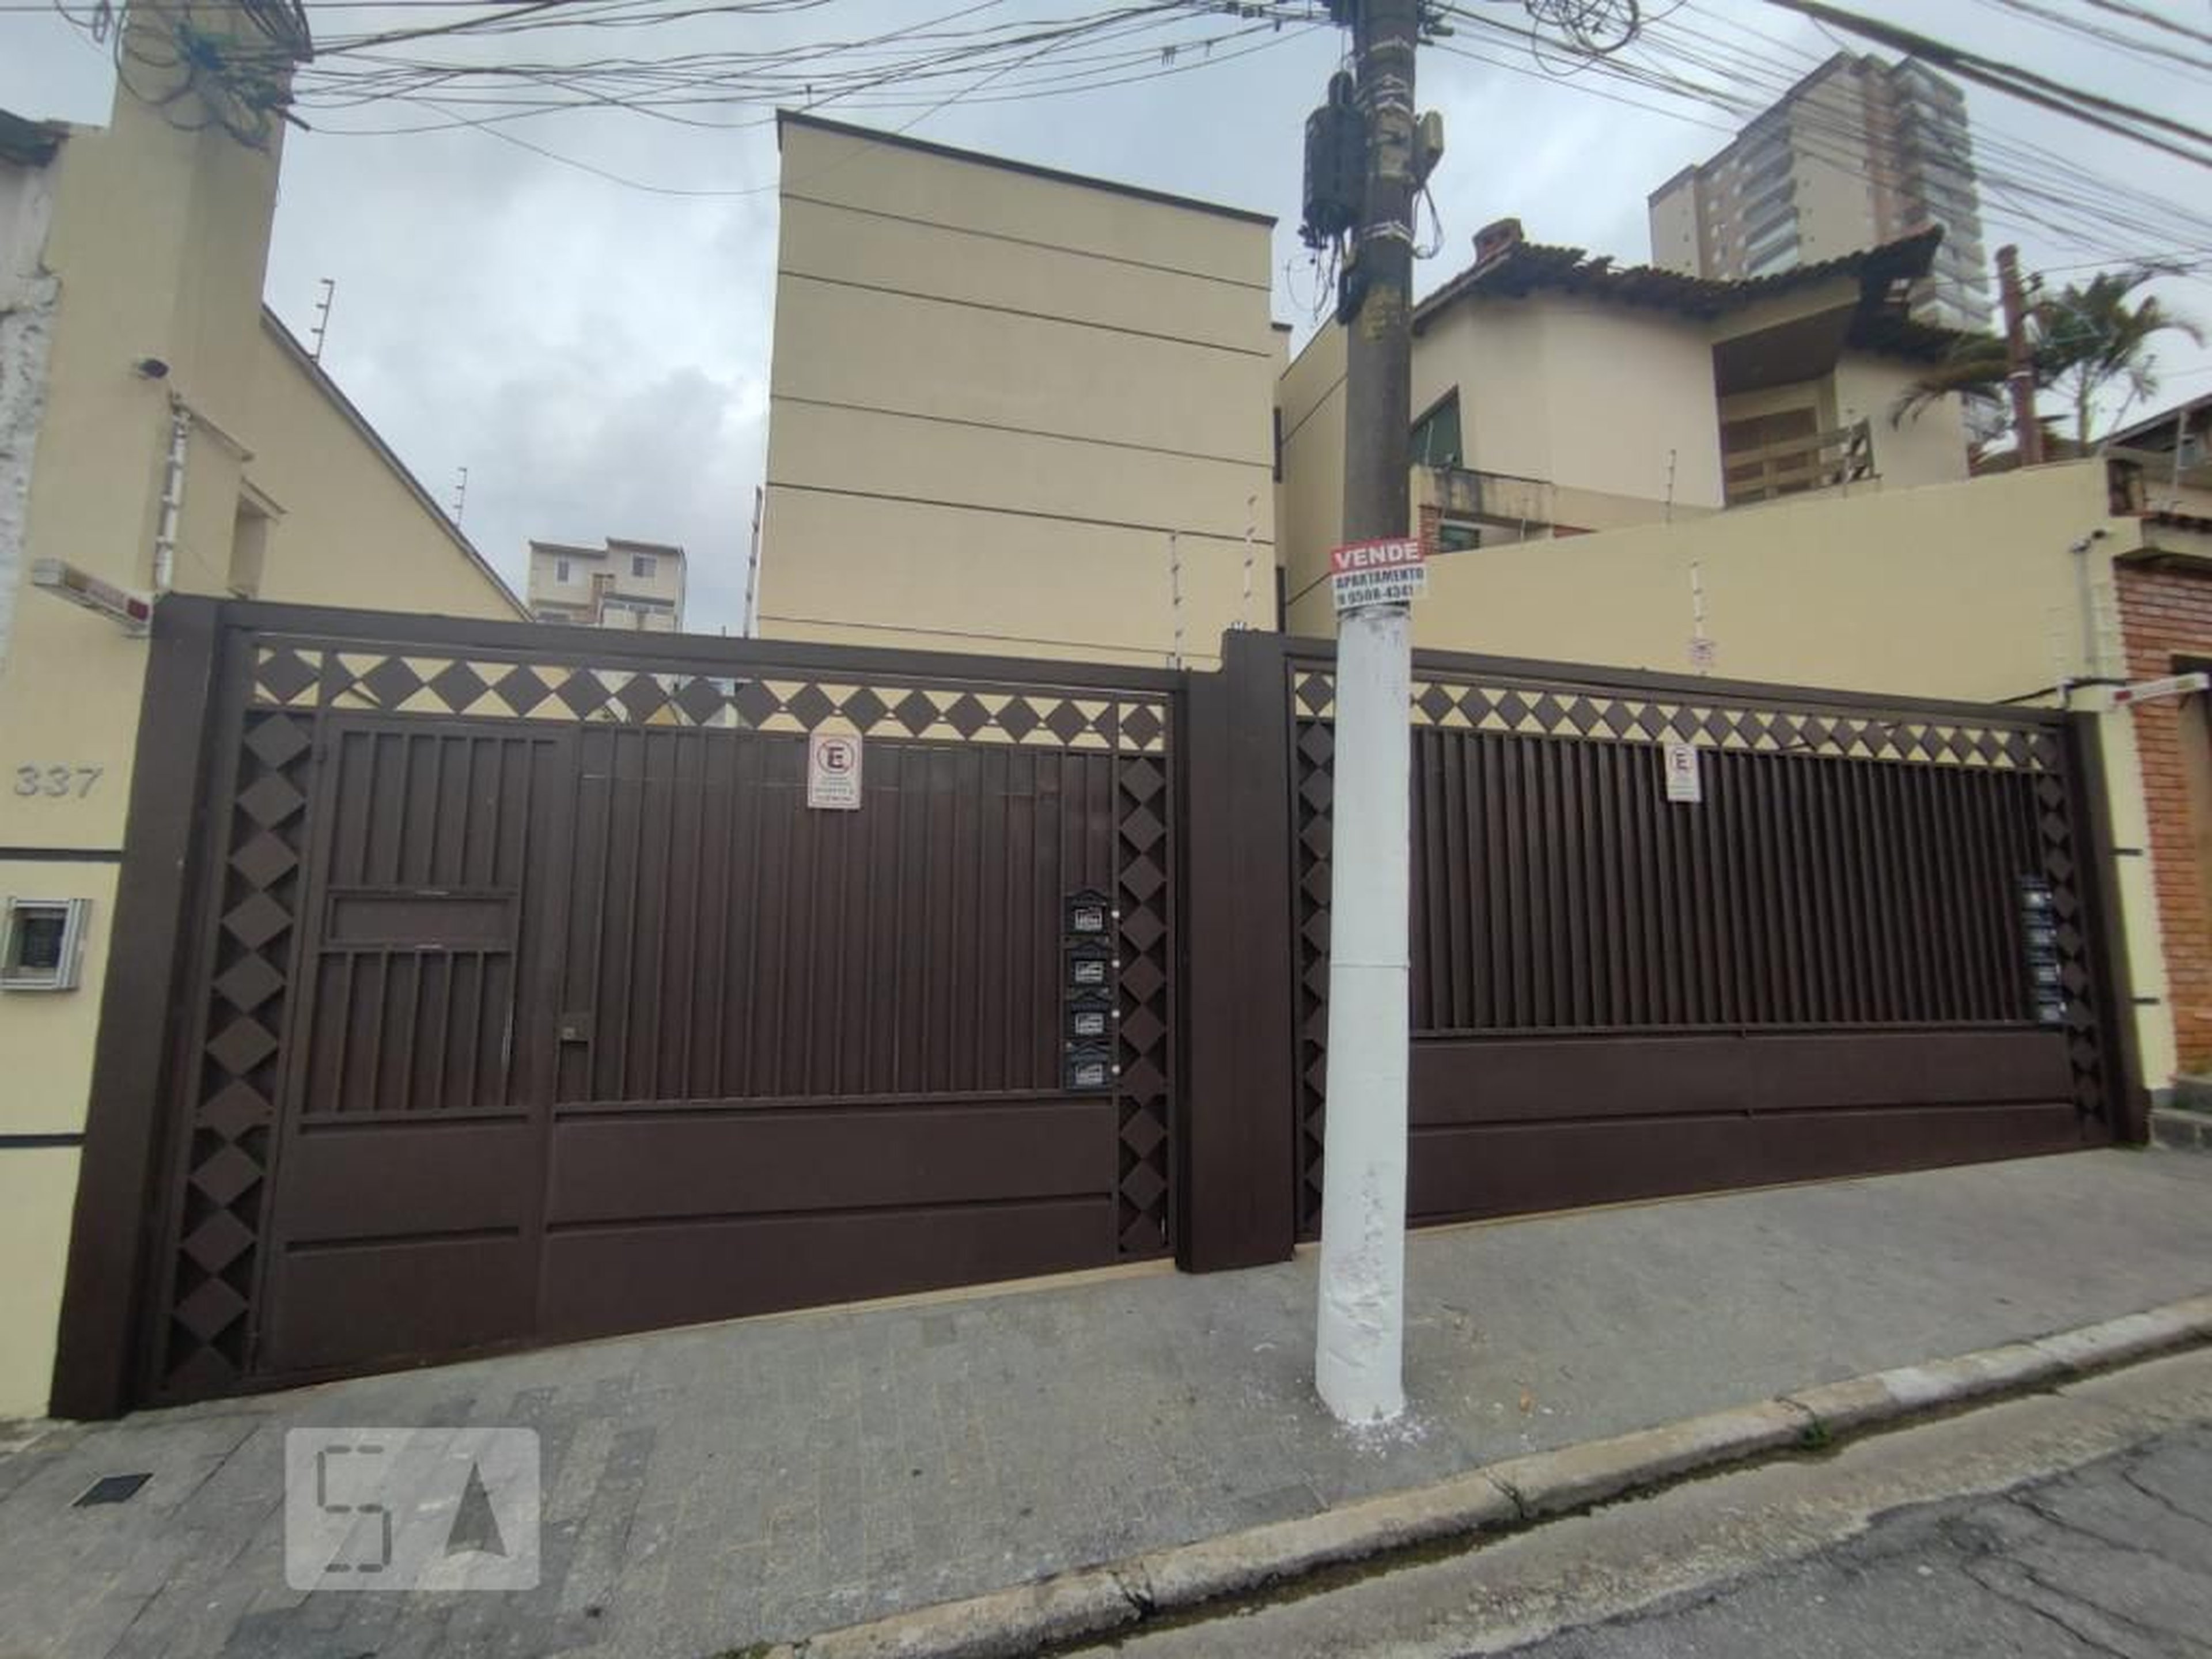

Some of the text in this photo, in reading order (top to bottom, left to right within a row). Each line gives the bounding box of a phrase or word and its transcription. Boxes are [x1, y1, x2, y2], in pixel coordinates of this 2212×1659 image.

[1334, 542, 1419, 569] VENDE
[1336, 567, 1425, 589] APARTAMENTO
[827, 747, 844, 769] E
[14, 766, 104, 798] 337
